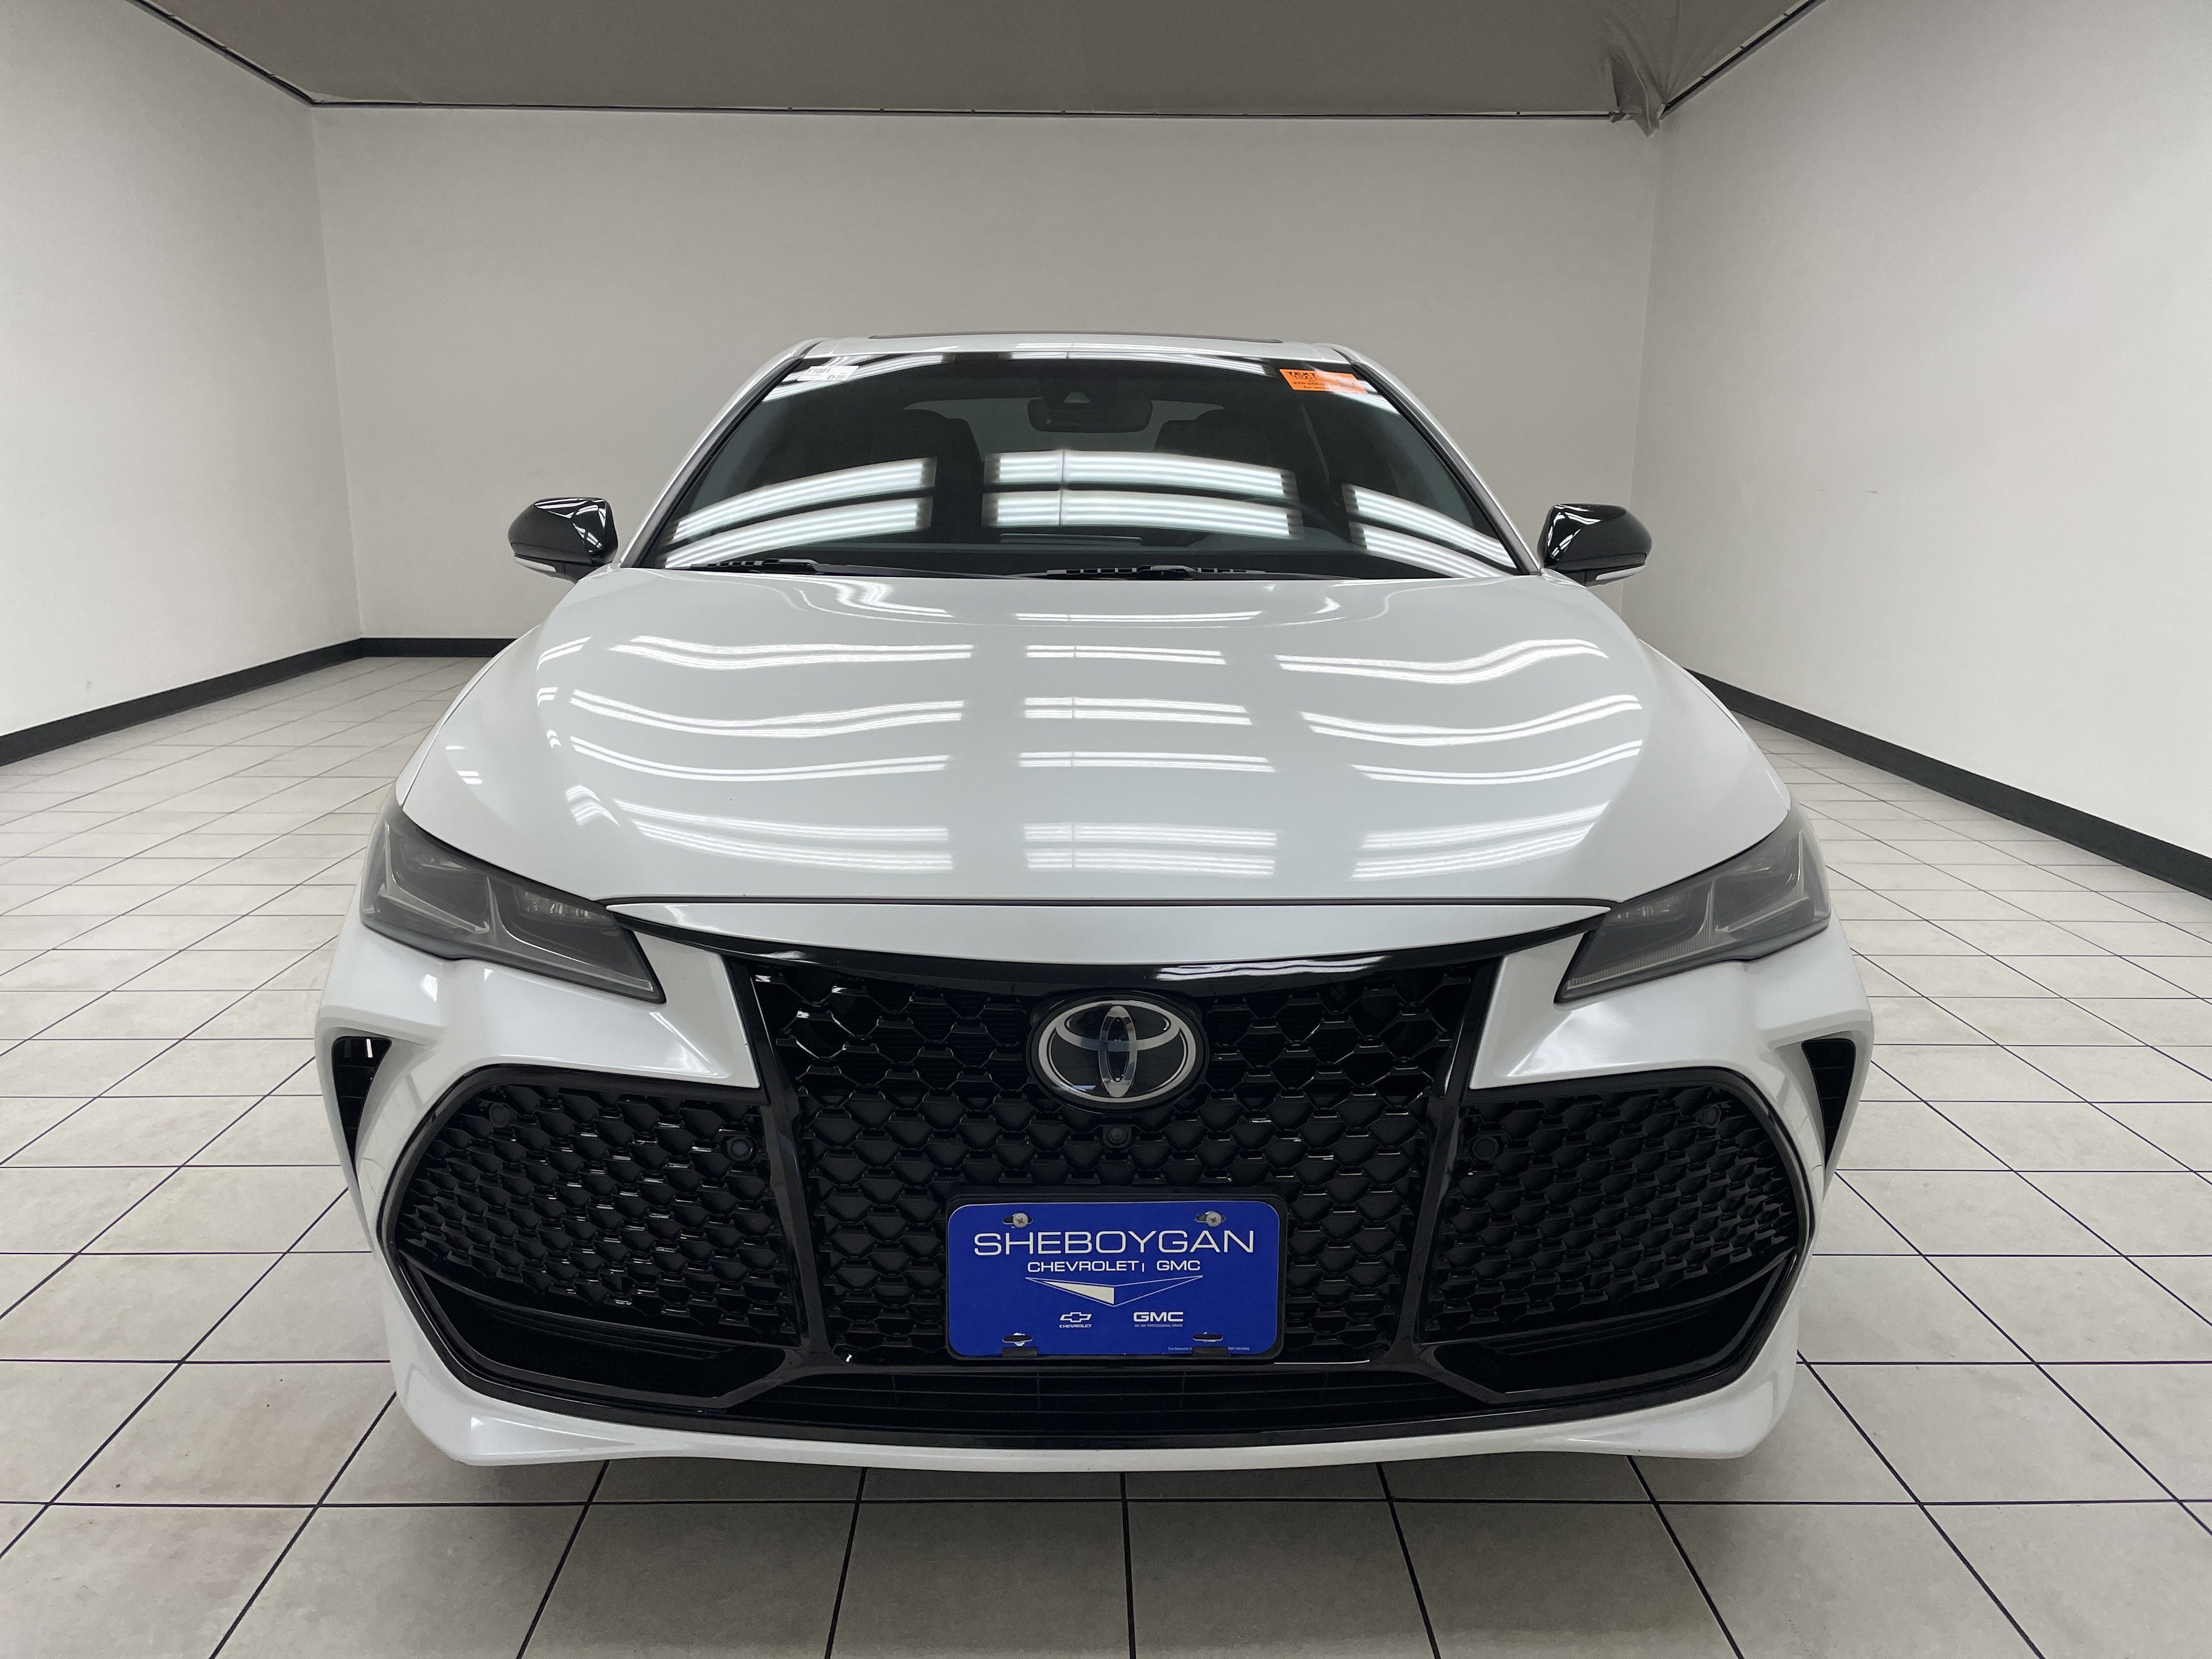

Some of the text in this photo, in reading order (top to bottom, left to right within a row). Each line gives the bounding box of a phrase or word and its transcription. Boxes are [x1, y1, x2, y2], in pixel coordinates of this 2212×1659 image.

[974, 1230, 1254, 1256] SHEBOYGAN
[1156, 1260, 1201, 1271] GMC
[1133, 1312, 1184, 1322] GMC
